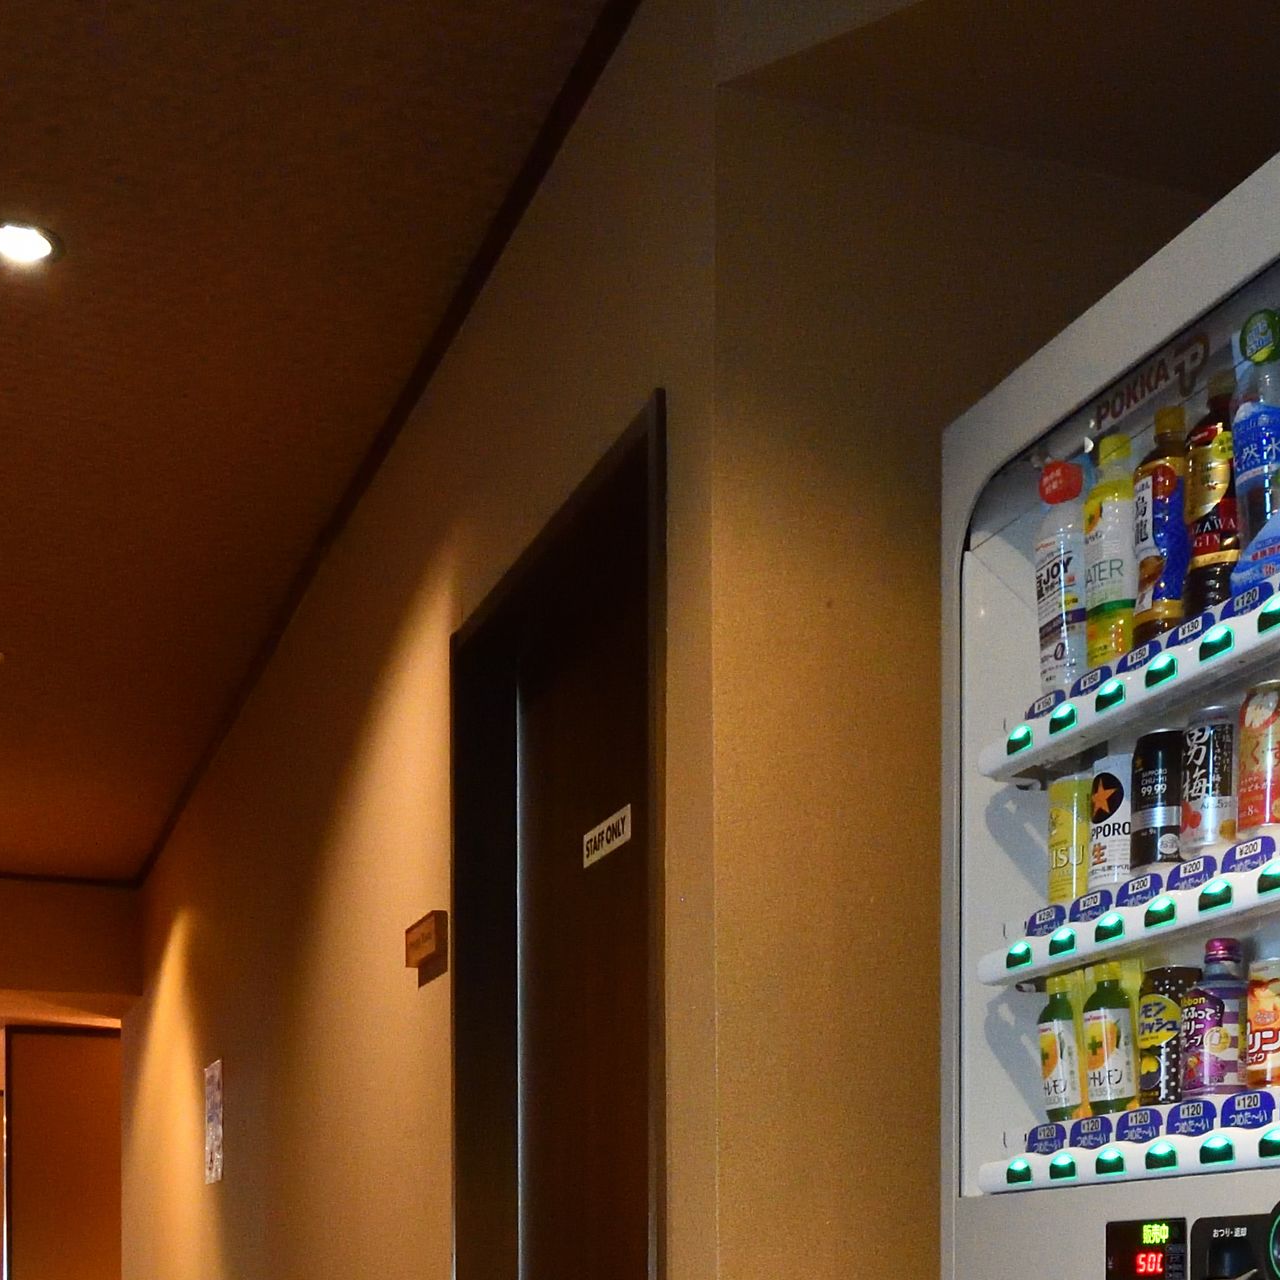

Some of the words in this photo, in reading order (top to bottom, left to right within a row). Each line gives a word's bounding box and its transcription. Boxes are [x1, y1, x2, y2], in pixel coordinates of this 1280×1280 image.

[1095, 358, 1170, 431] POKKA
[1183, 724, 1211, 802] 男梅
[586, 829, 605, 859] STAFF
[606, 815, 626, 845] ONLY
[1092, 842, 1107, 867] 生
[1238, 841, 1258, 857] ¥200
[1181, 860, 1201, 876] ¥200
[1181, 1103, 1202, 1117] ¥120
[1237, 1094, 1259, 1109] ¥120
[1130, 1112, 1149, 1126] ¥120
[1142, 1223, 1170, 1245] 販売中
